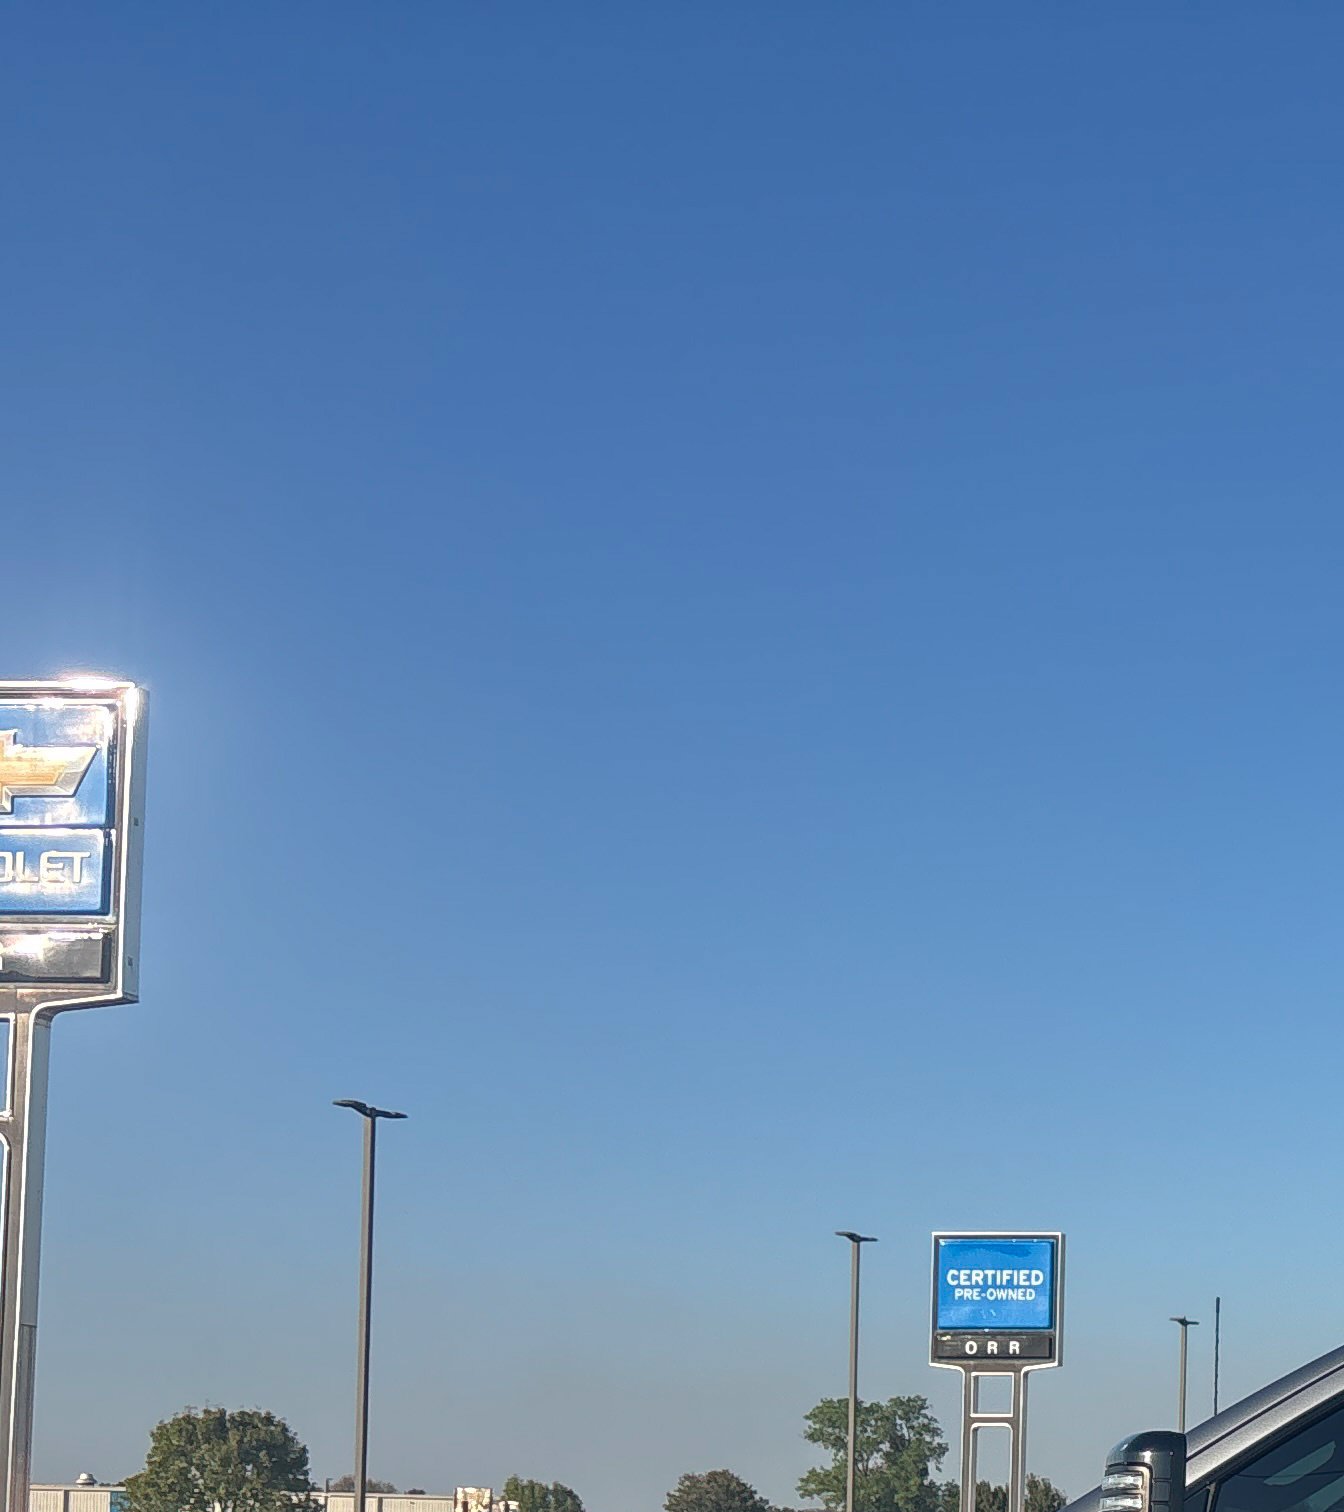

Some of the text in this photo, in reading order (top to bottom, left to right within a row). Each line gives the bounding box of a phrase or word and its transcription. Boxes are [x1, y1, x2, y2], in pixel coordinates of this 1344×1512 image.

[946, 1269, 1044, 1286] CERTIFIED
[954, 1288, 1036, 1301] PRE-OWNED
[965, 1341, 1020, 1355] ORR
